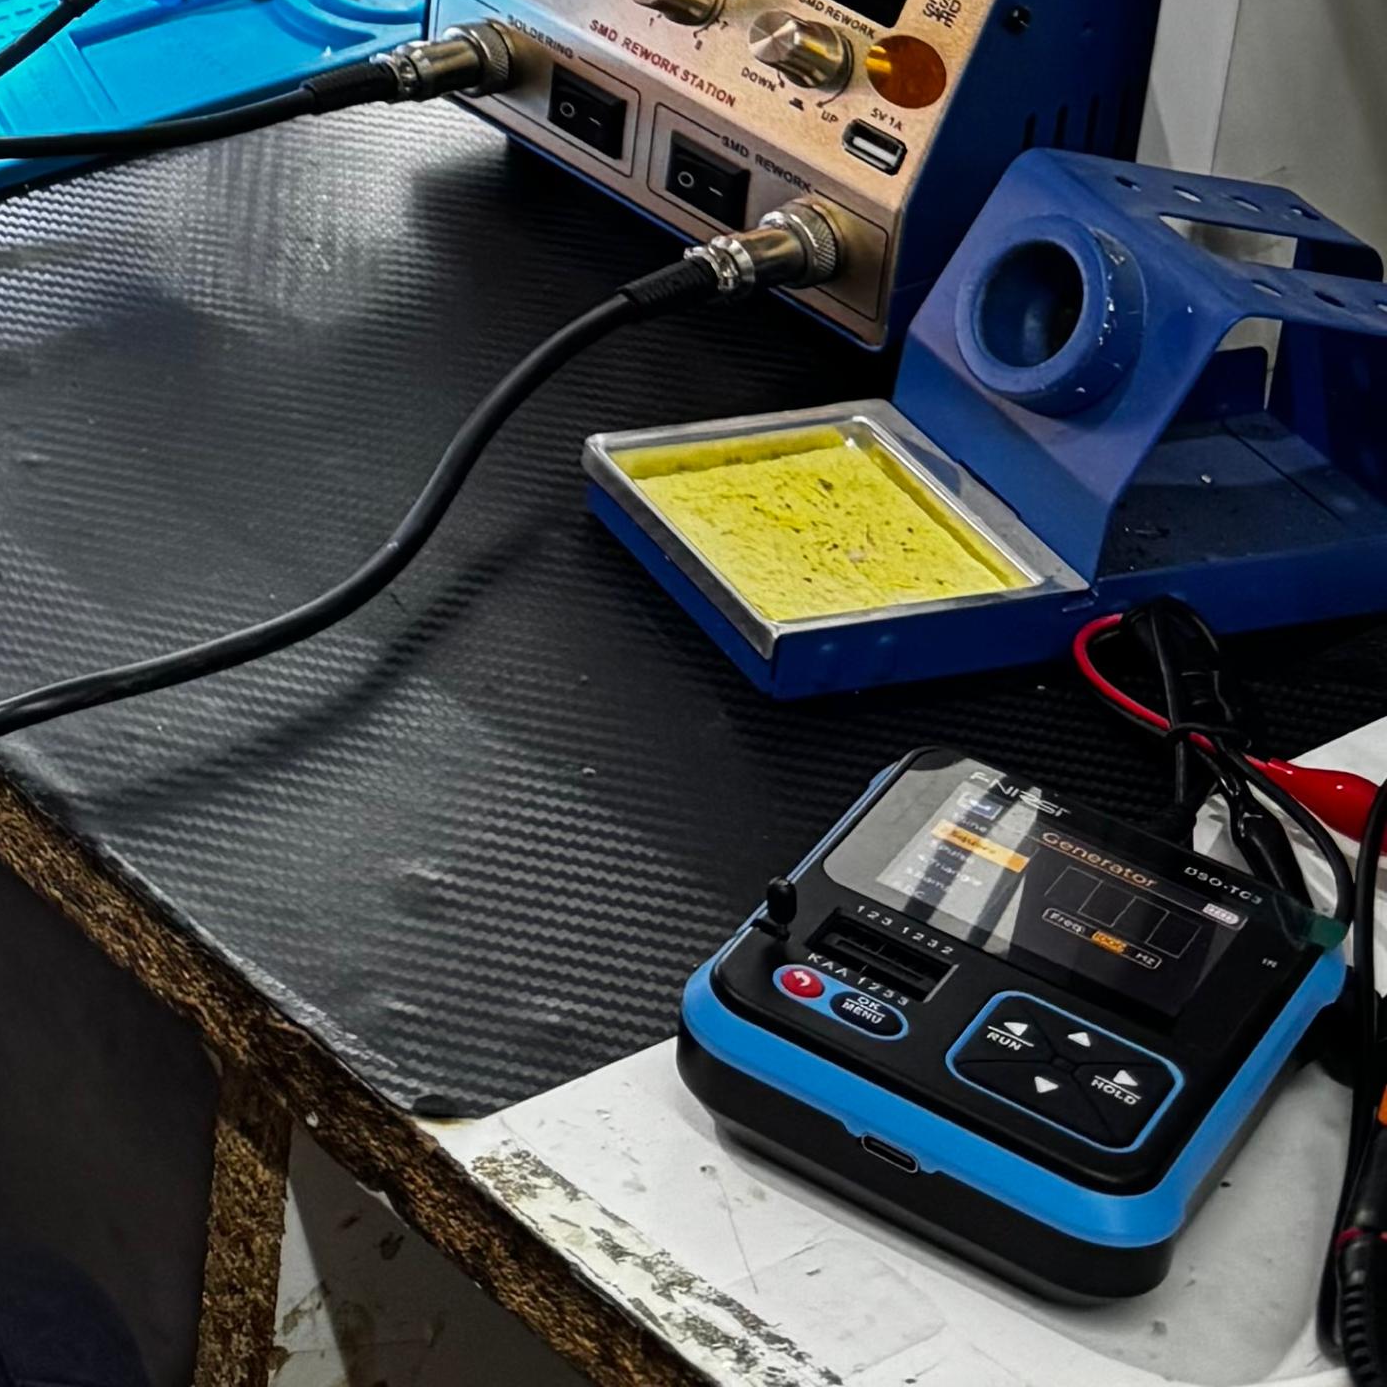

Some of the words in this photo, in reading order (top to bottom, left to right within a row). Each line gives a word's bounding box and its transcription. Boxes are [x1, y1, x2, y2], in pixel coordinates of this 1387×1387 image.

[507, 13, 575, 60] SOLDERING
[827, 6, 876, 40] REWORK
[589, 19, 618, 42] SMD
[622, 37, 680, 77] REWORK
[679, 68, 737, 108] STATION
[740, 66, 777, 93] DOWN
[820, 109, 840, 124] UP
[721, 134, 750, 159] SMD
[754, 153, 813, 194] REWORK
[1041, 831, 1159, 889] Generator
[1184, 865, 1264, 906] DSO-TC3
[841, 1001, 883, 1025] MENU
[857, 995, 882, 1010] OK
[986, 1031, 1023, 1051] RUN
[1090, 1078, 1137, 1106] HOLD
